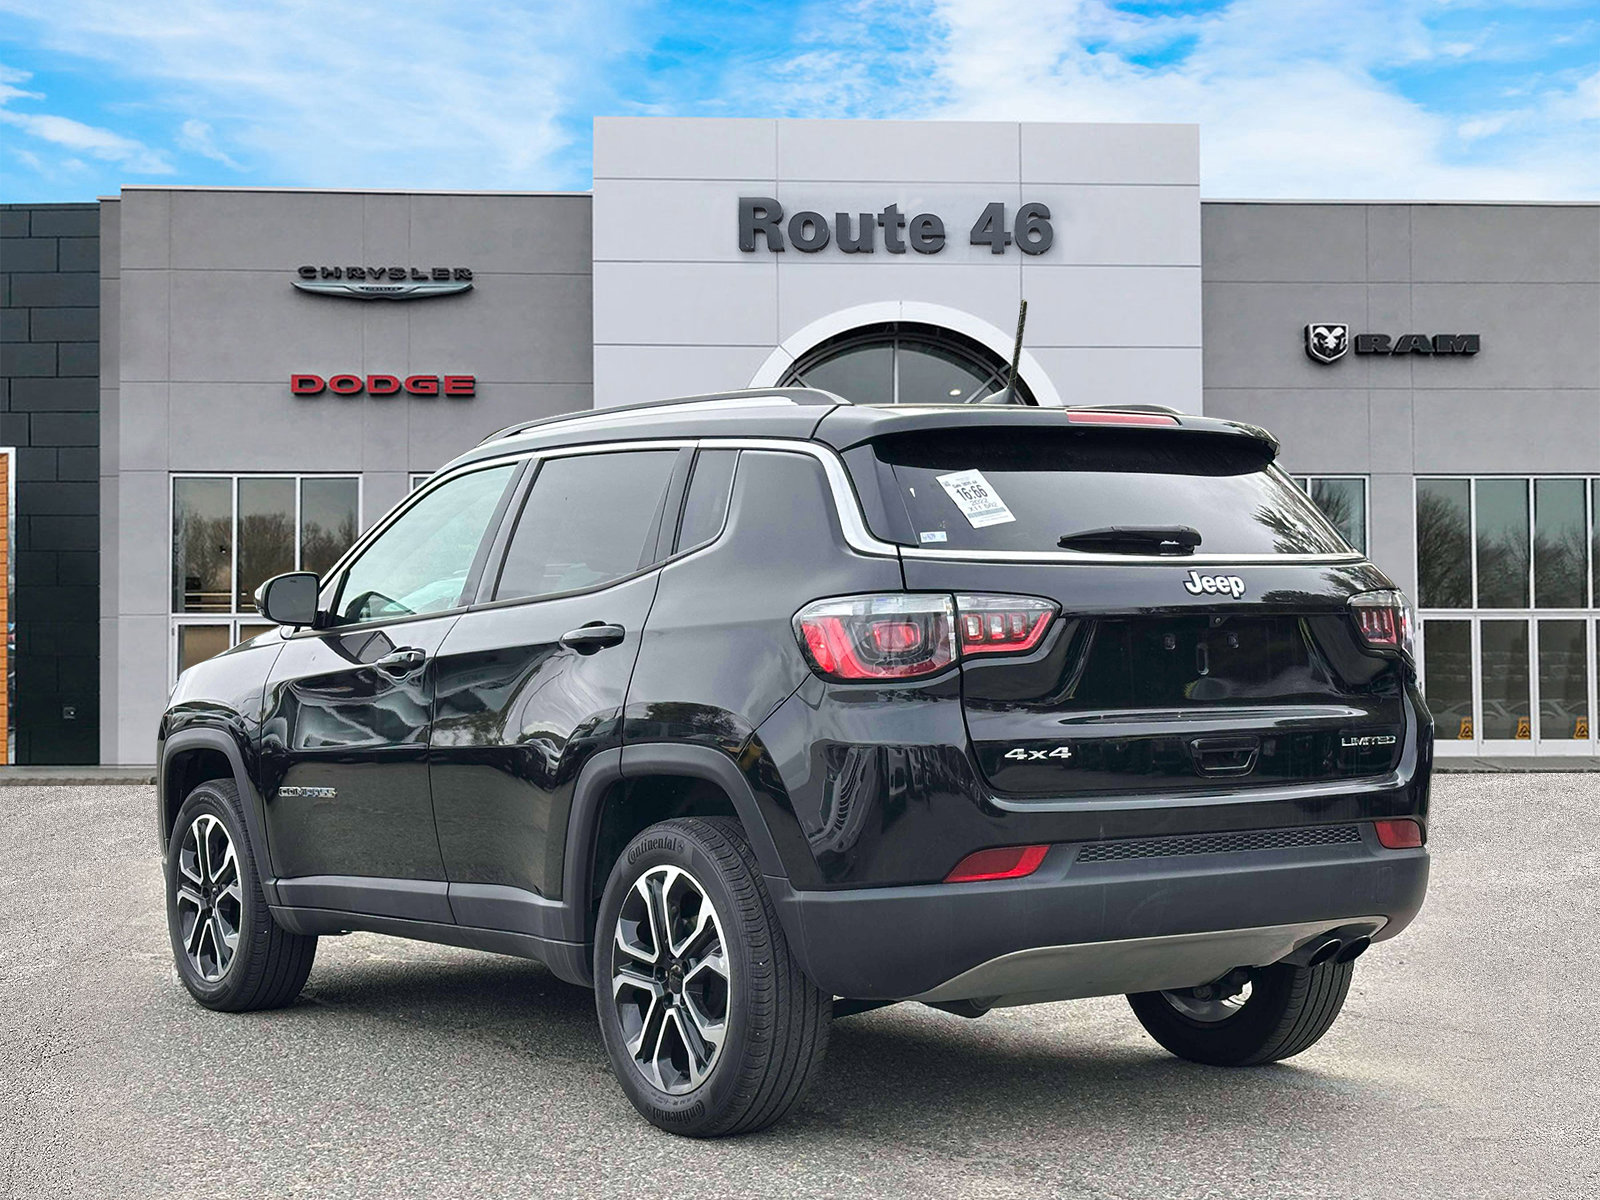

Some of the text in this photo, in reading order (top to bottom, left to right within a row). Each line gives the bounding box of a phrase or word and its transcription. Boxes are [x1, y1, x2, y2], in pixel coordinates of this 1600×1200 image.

[738, 197, 1054, 255] Route 46
[298, 265, 473, 280] CHRYSLER
[1354, 333, 1480, 355] RAM
[291, 374, 475, 397] DODGE
[1183, 570, 1246, 600] Jeep
[1341, 735, 1397, 747] LIMITED
[1004, 746, 1072, 760] 4x4
[627, 835, 676, 865] Continental
[653, 1100, 706, 1125] Continental
